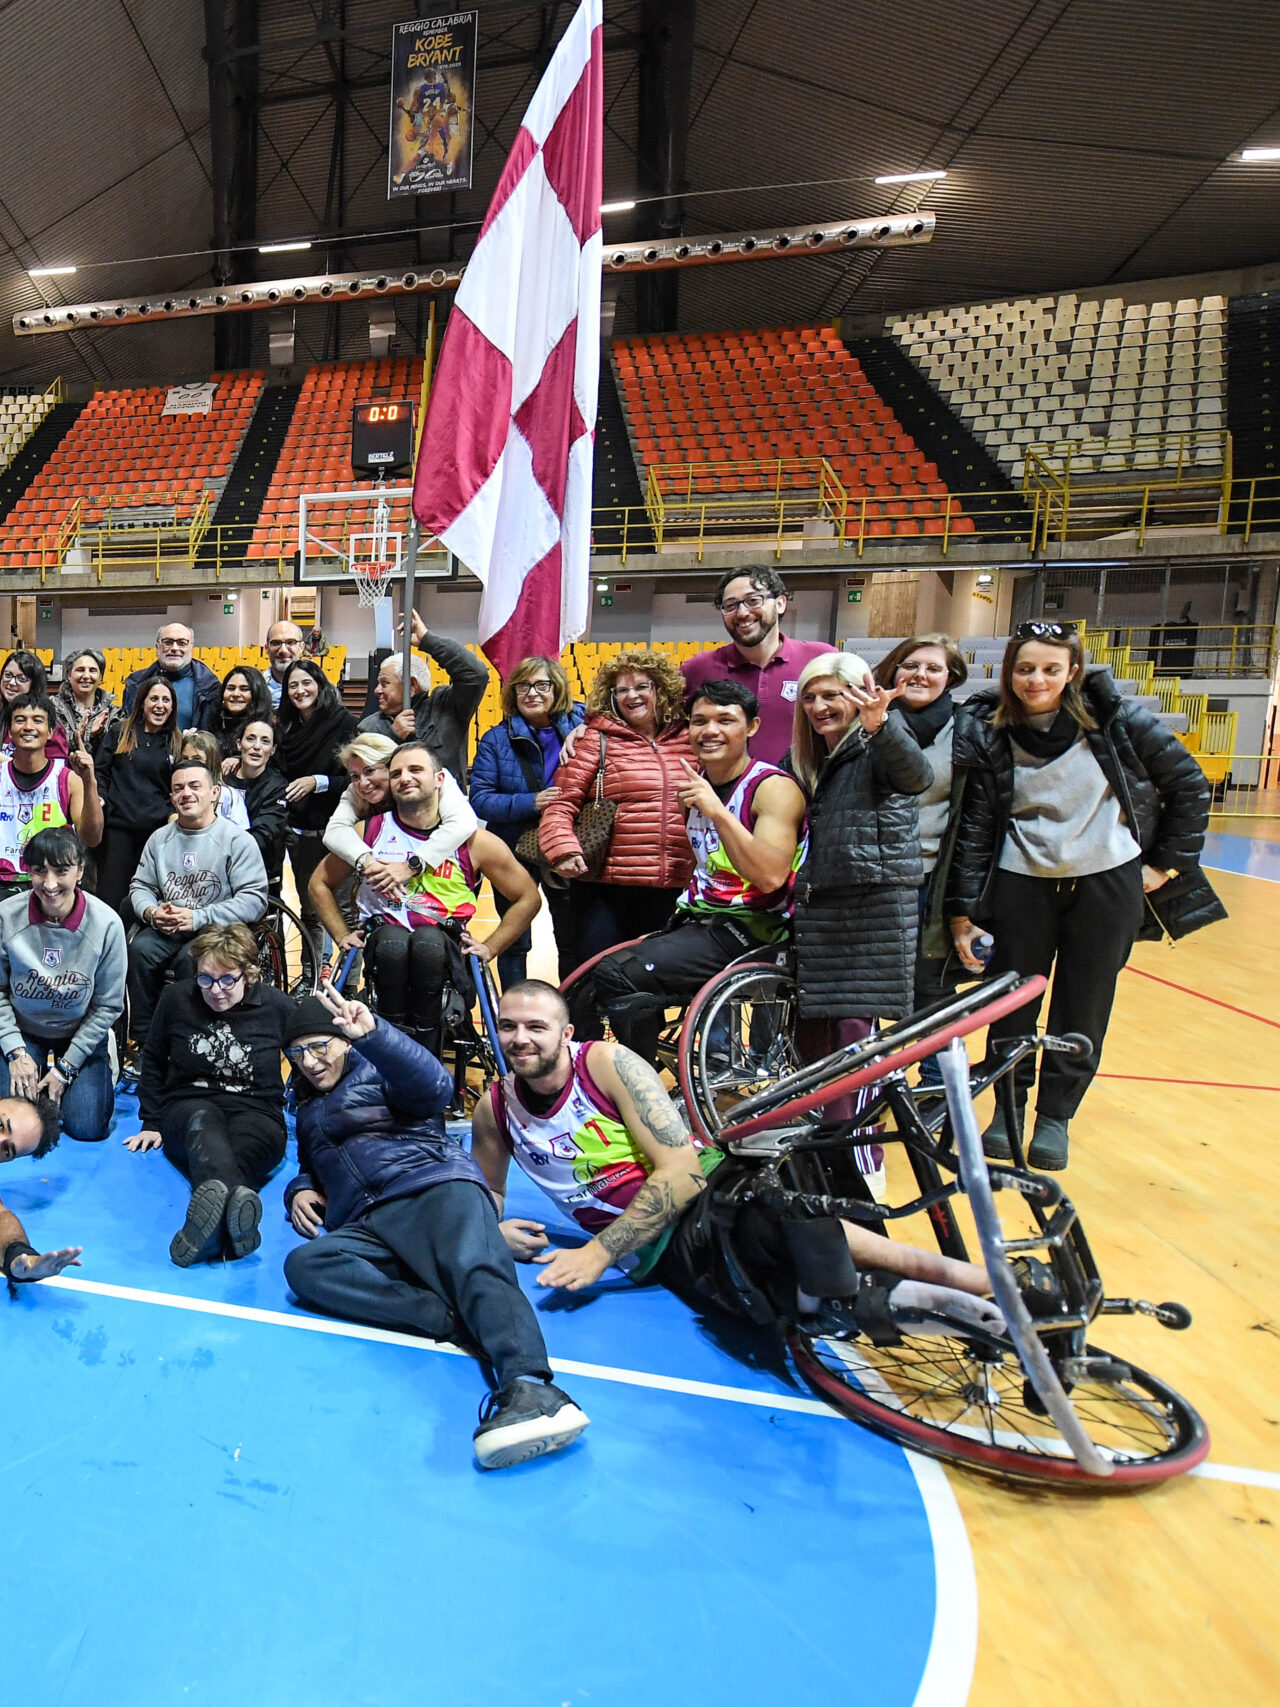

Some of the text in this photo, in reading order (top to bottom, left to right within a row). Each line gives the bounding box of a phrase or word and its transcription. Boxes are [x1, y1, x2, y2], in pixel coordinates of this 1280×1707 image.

[399, 13, 473, 35] REGGIO CALABRIA
[422, 27, 449, 36] REMEMBER
[415, 33, 454, 52] KOBE
[407, 45, 465, 69] BRYANT
[423, 96, 441, 113] 24
[42, 803, 51, 822] 2
[163, 871, 208, 890] Reggio
[26, 968, 78, 992] Reggio
[15, 982, 81, 1001] Calabria
[584, 1119, 612, 1147] 7
